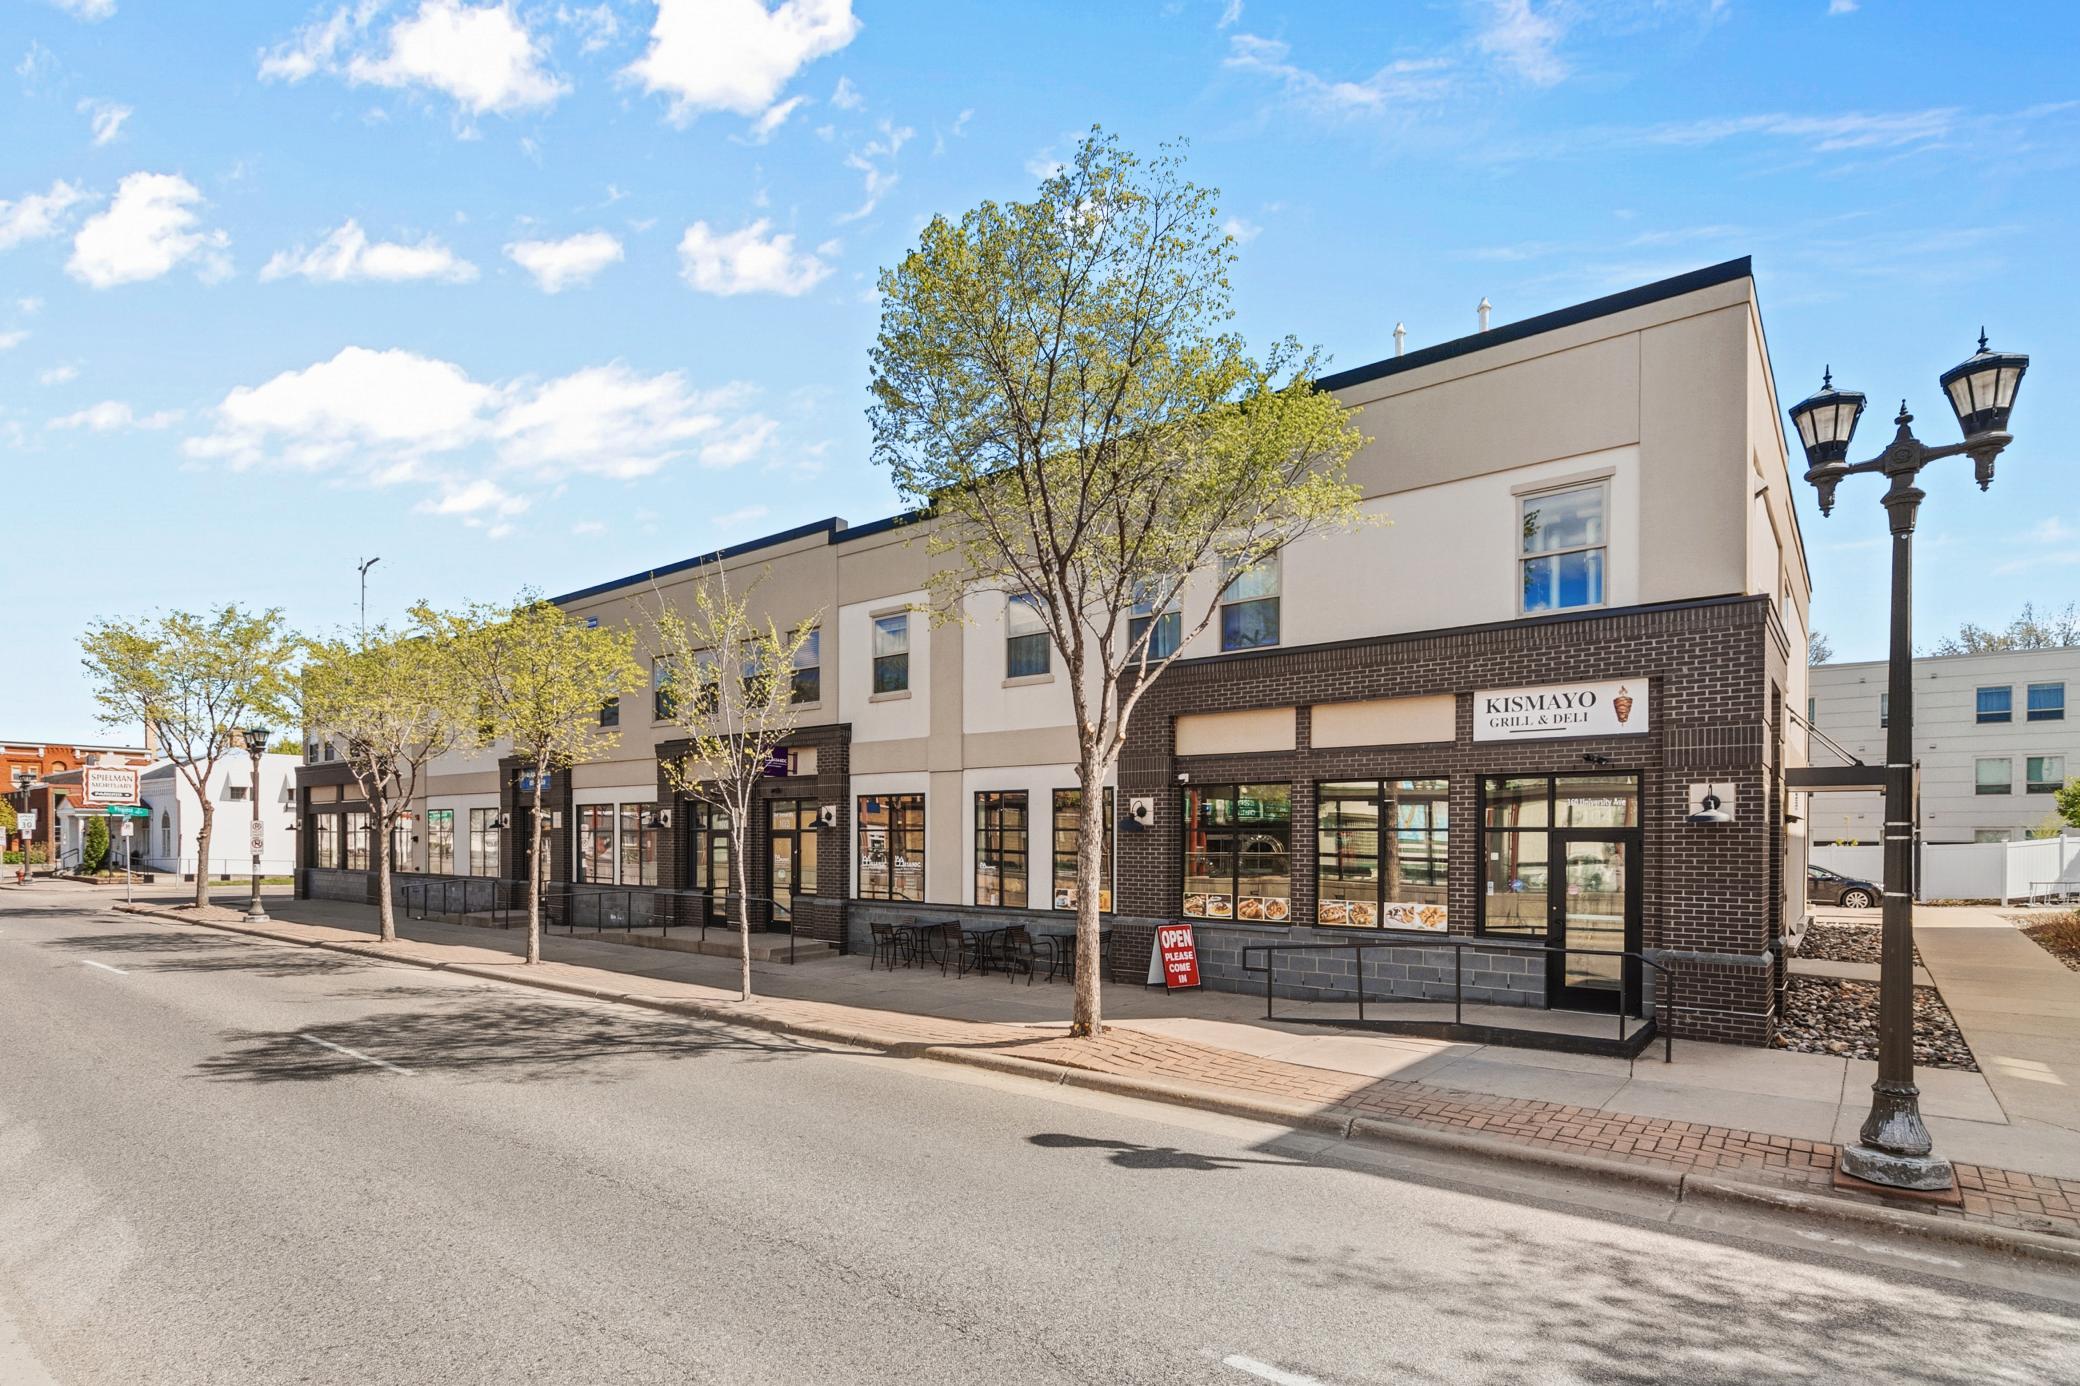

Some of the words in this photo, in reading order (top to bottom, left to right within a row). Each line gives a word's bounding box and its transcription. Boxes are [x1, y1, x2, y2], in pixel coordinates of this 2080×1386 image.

[1485, 690, 1597, 714] KISMAYO
[1489, 715, 1533, 728] GRILL
[1537, 714, 1548, 725] &
[1553, 712, 1588, 724] DELI
[91, 773, 133, 782] SPIELMAN
[1161, 929, 1193, 948] OPEN
[1164, 951, 1194, 961] PLEASE
[1168, 962, 1192, 973] COME
[1178, 974, 1188, 983] IN
